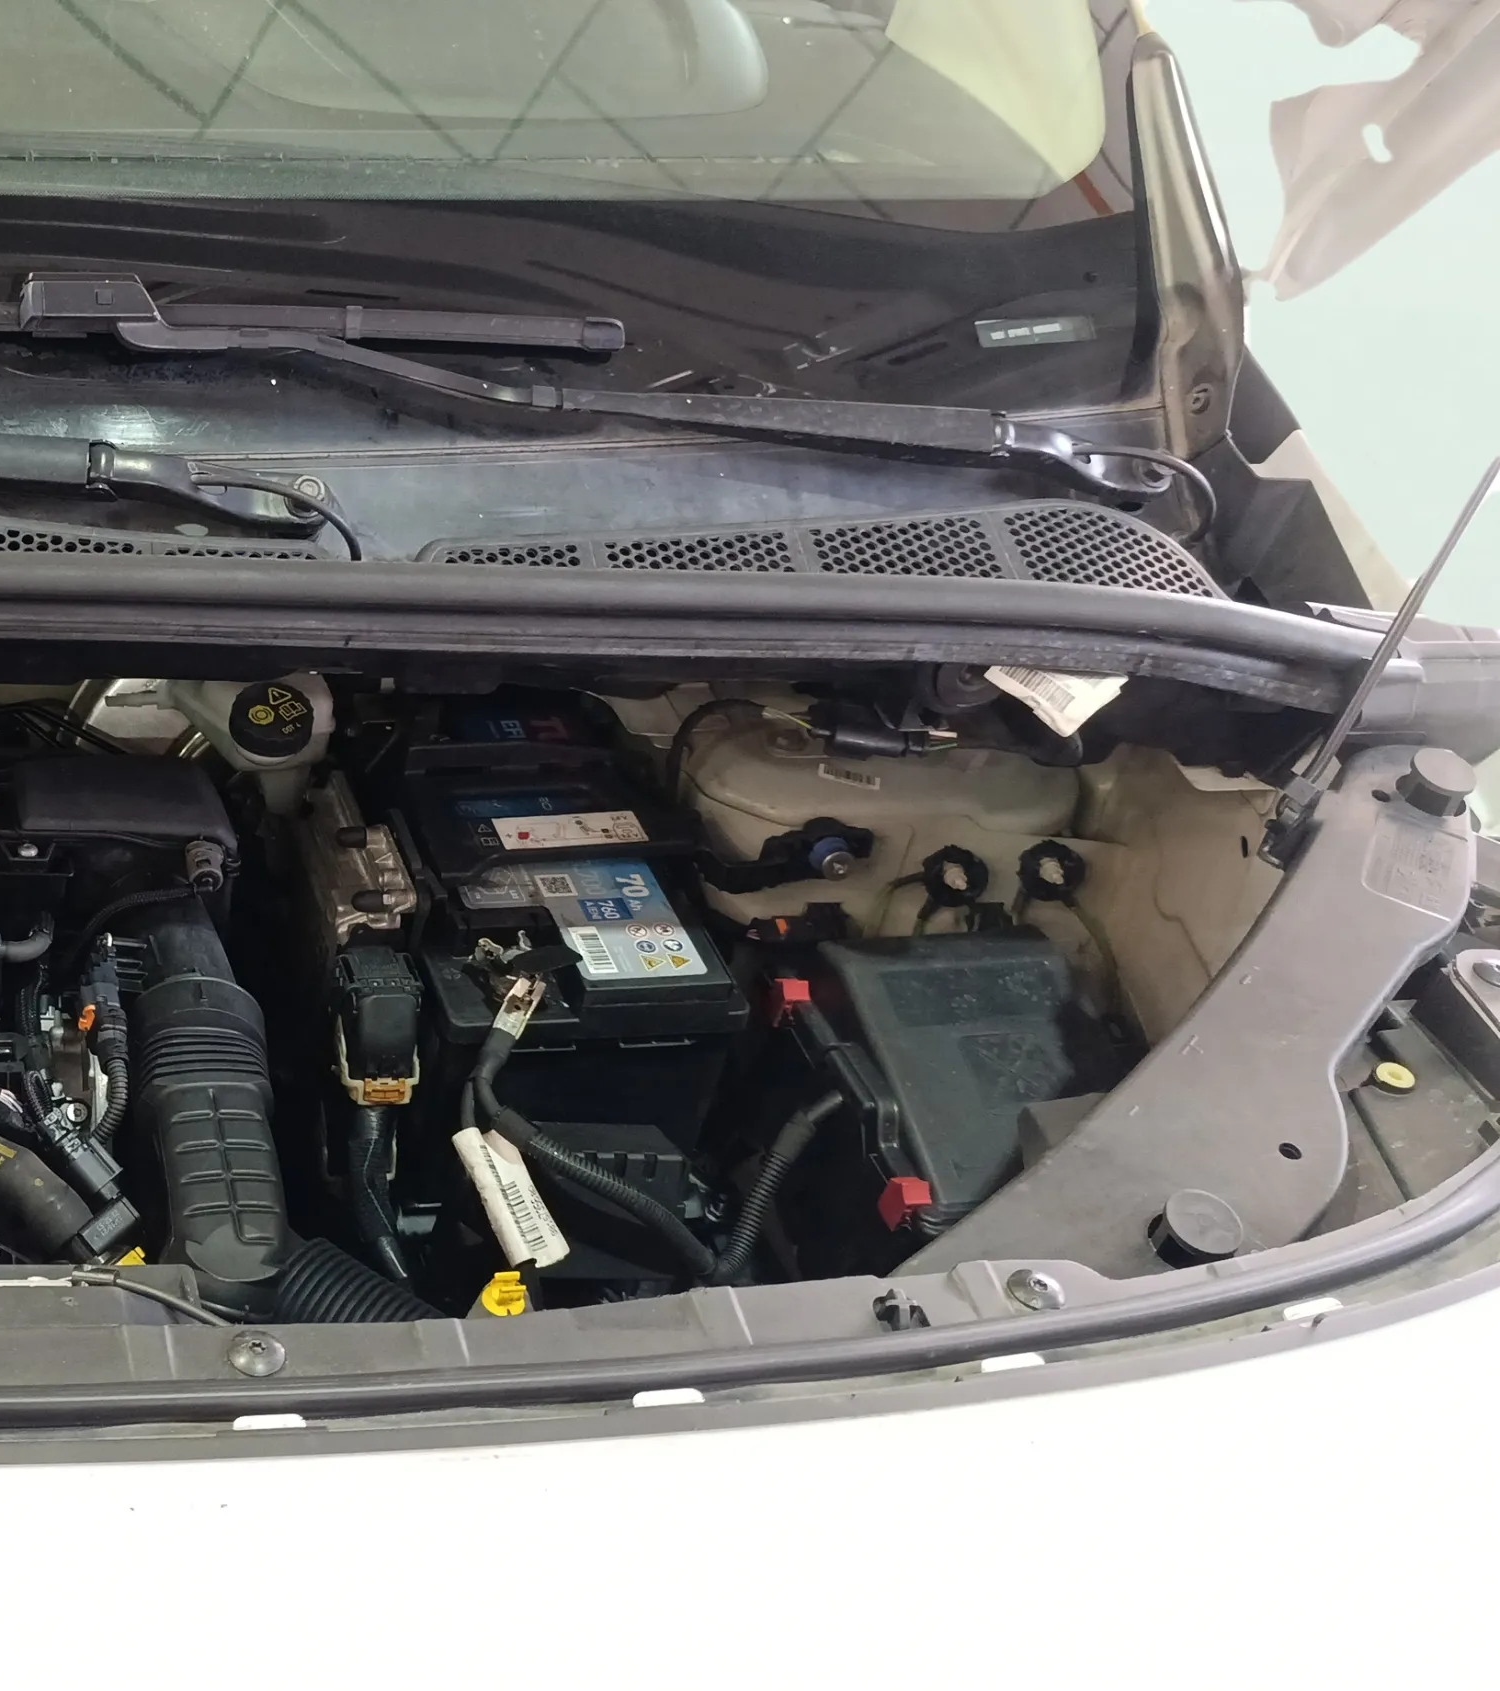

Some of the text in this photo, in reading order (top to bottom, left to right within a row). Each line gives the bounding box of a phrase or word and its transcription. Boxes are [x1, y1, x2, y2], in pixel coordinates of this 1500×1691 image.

[281, 723, 296, 734] DOT
[615, 873, 650, 912] 70 Ah
[598, 900, 621, 920] 760
